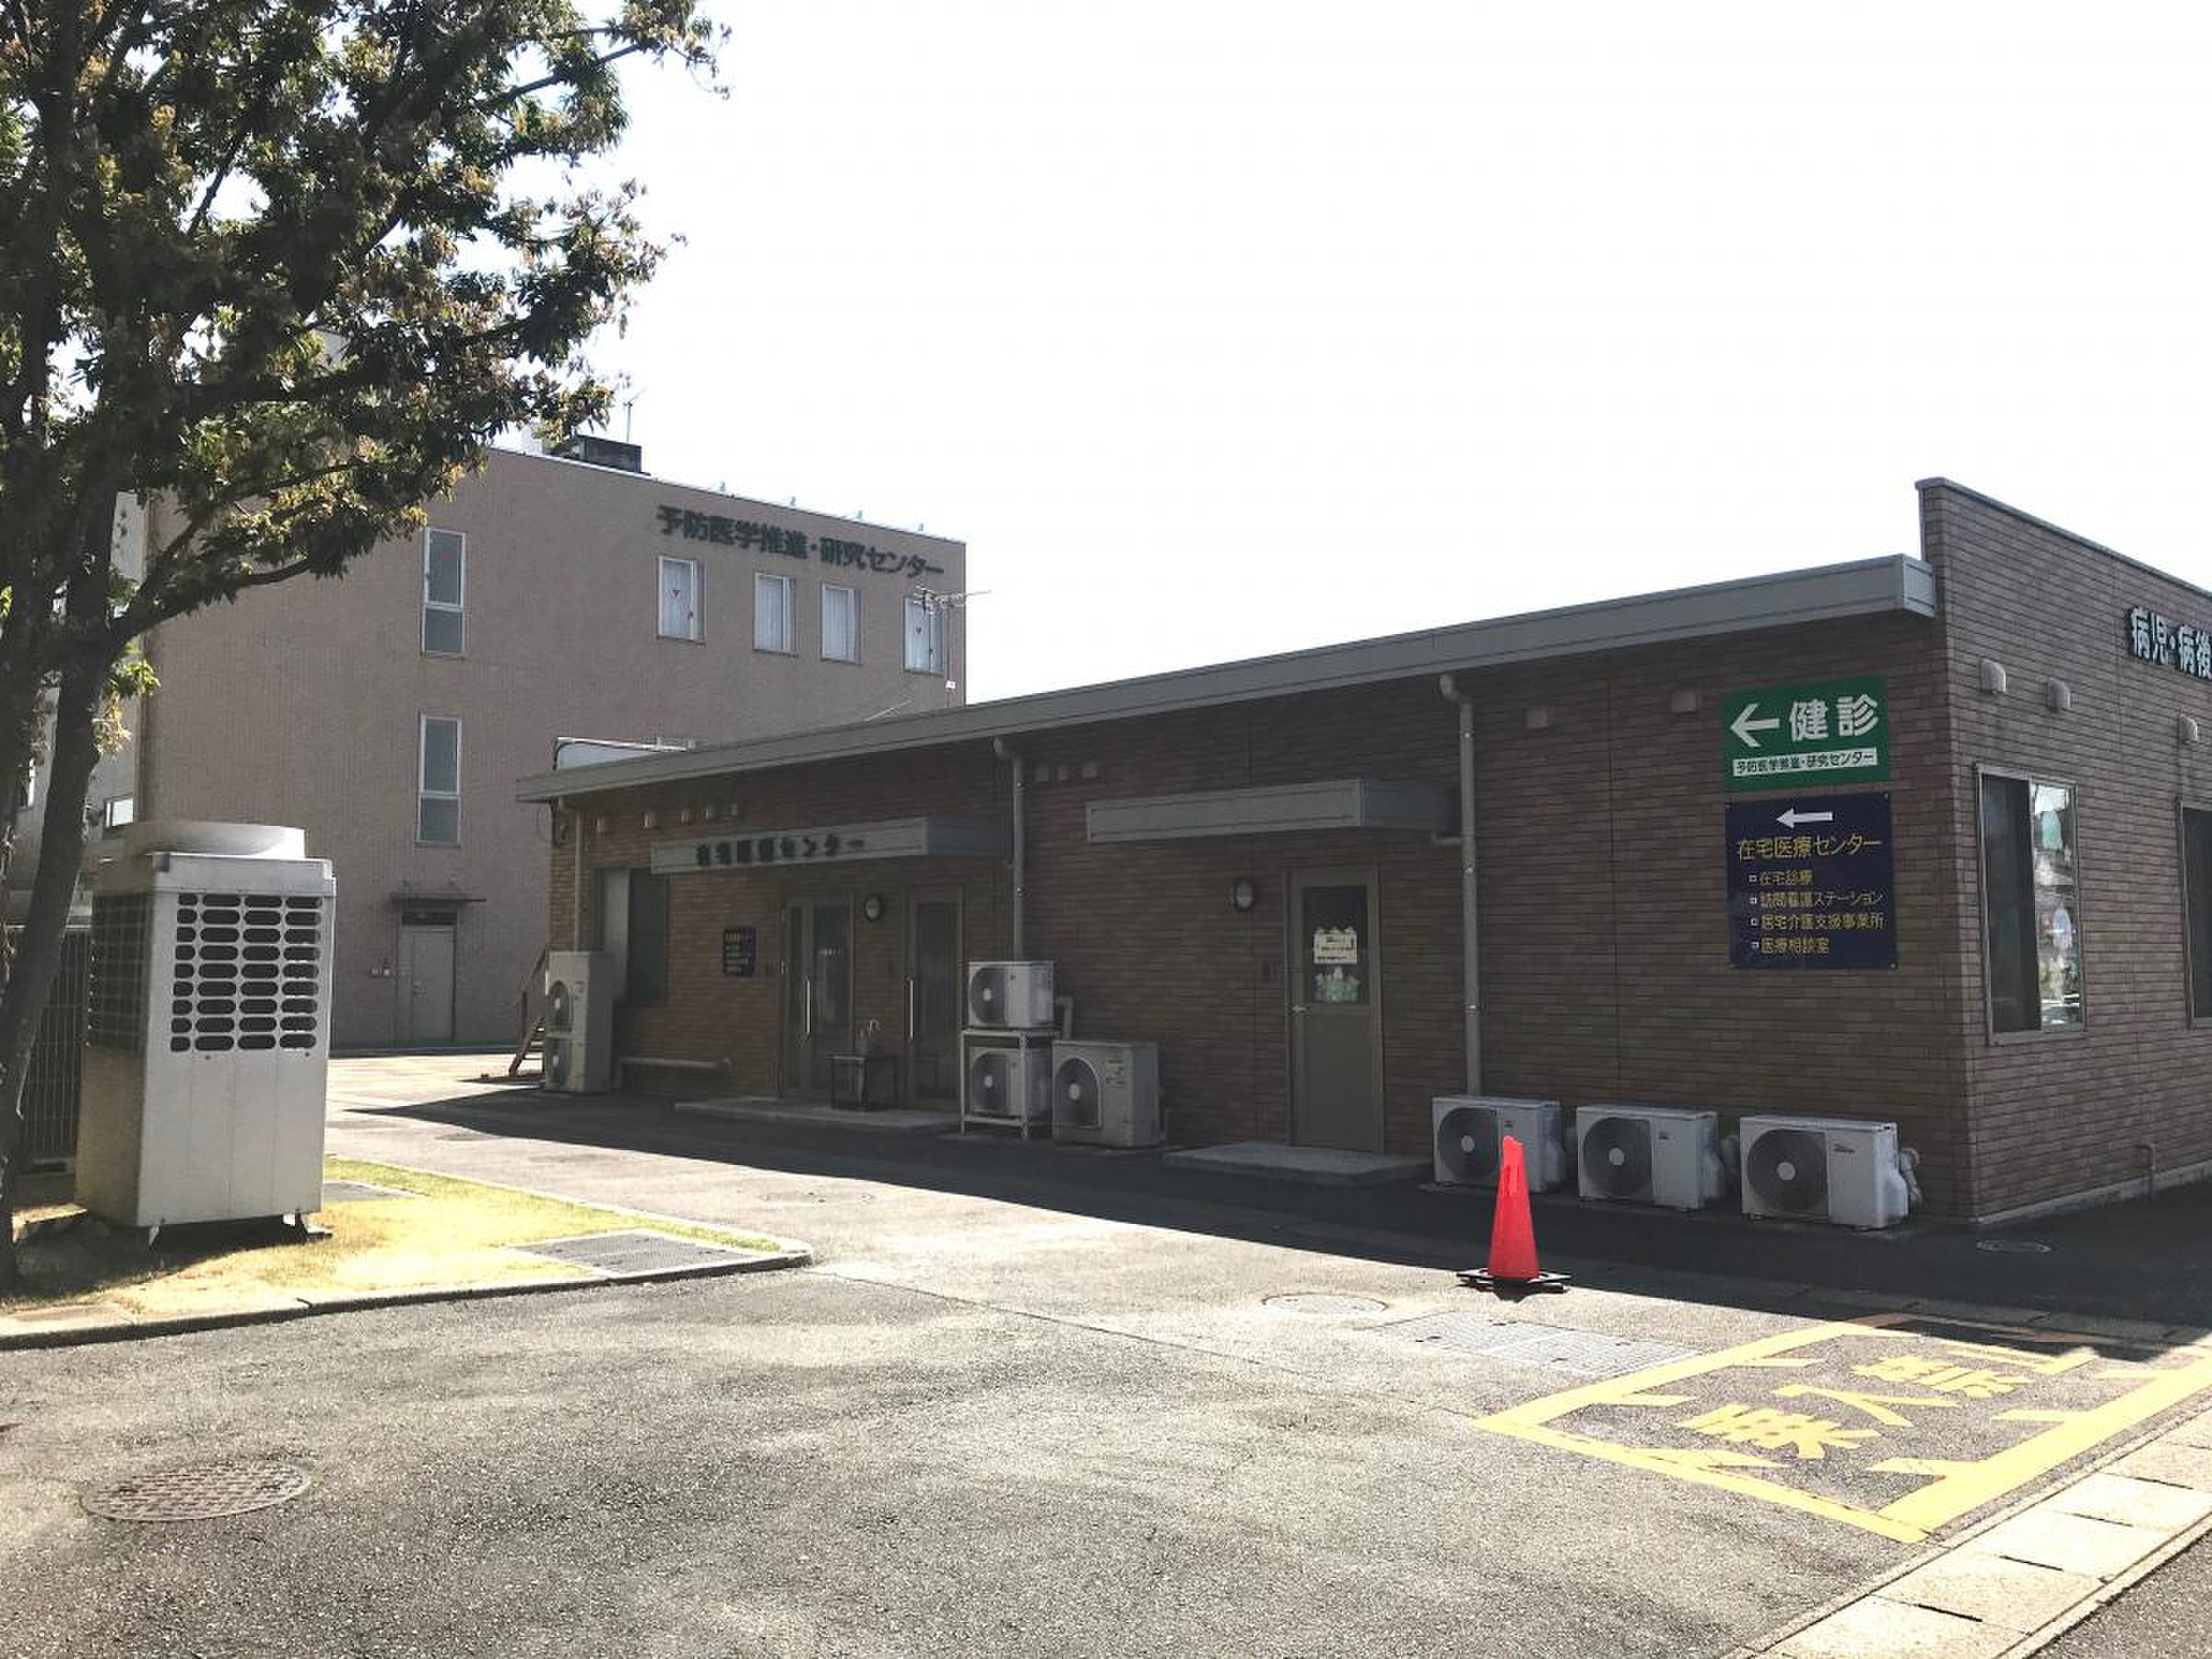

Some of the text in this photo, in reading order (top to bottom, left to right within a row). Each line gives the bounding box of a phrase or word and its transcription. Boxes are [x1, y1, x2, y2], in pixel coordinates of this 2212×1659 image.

[1789, 694, 1878, 741] 健診
[1738, 833, 1883, 861] 在宅医療センター
[1759, 870, 1813, 886] 在宅診療
